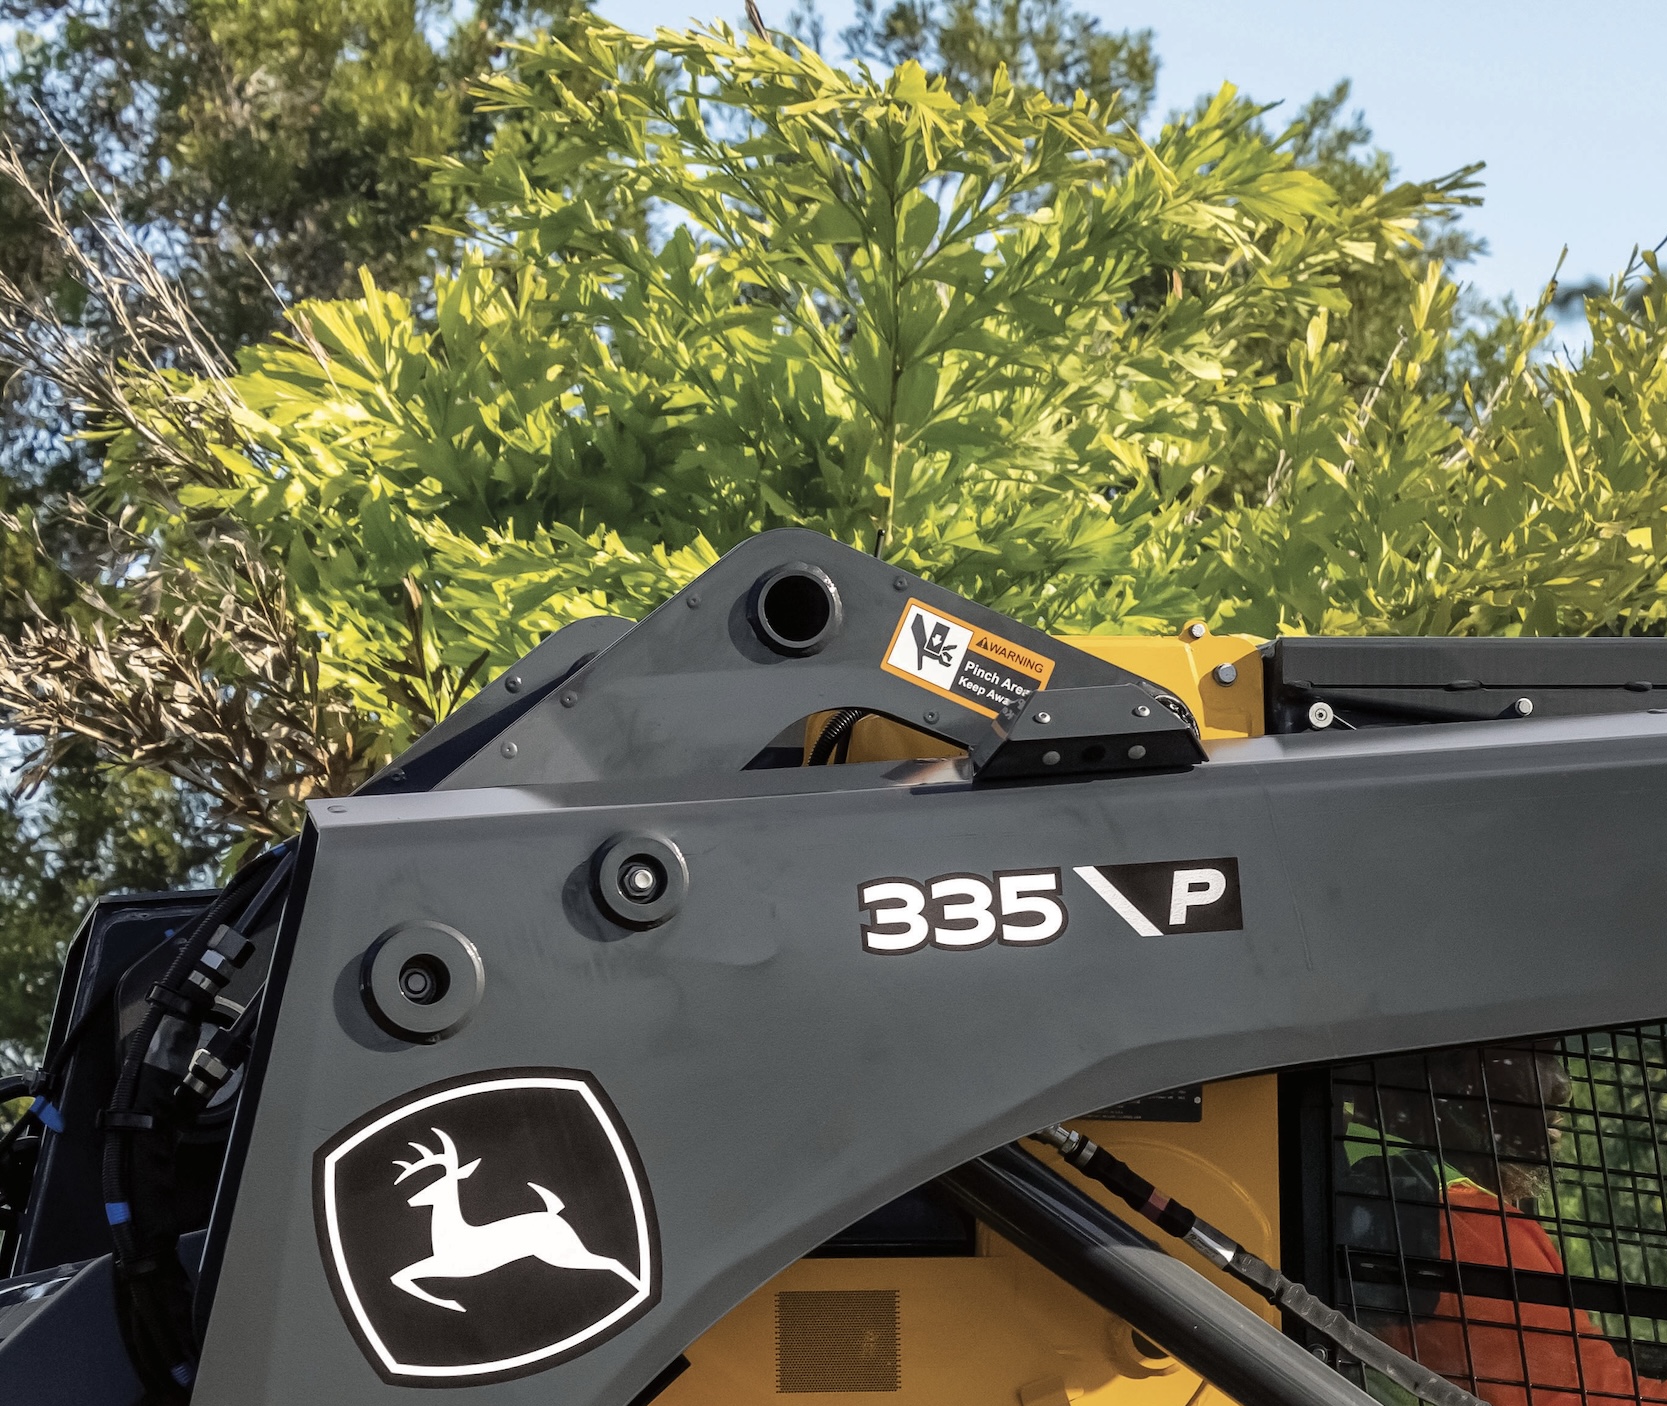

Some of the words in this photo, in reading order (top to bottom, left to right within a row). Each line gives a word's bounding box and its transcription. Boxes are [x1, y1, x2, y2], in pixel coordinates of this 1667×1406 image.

[964, 660, 1000, 685] Pinch
[989, 641, 1044, 673] WARNING
[958, 676, 986, 696] Keep
[986, 690, 1011, 706] Awa
[862, 873, 1064, 951] 335
